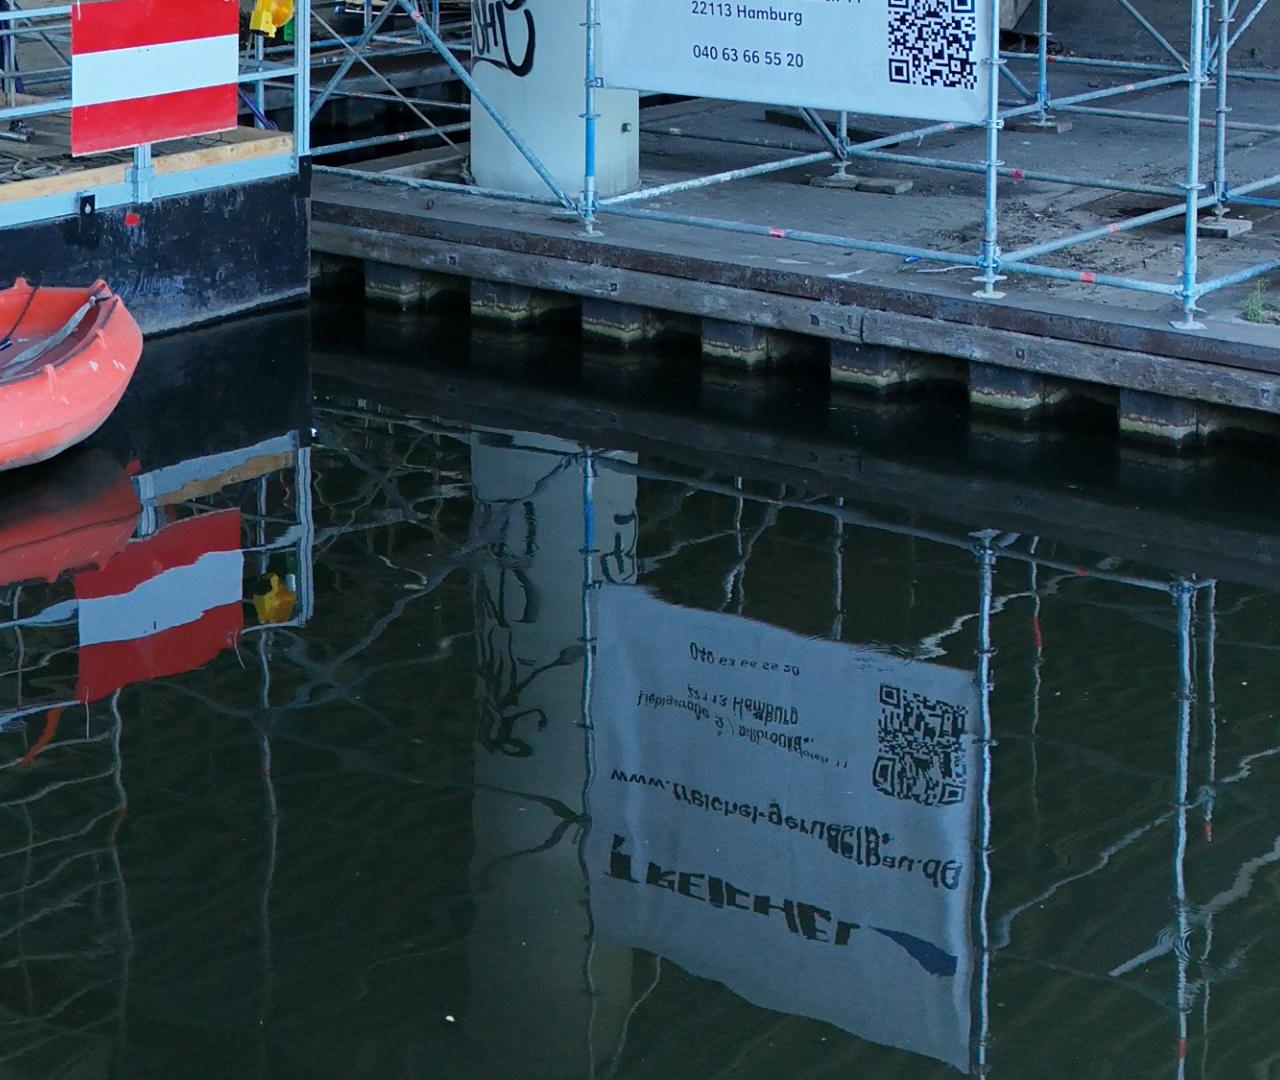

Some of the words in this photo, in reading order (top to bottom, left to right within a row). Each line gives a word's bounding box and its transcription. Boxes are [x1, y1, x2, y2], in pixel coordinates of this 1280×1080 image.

[691, 0, 732, 17] 22113
[736, 4, 803, 26] Hamburg
[692, 44, 718, 60] 040
[722, 47, 738, 62] 63
[743, 49, 760, 64] 66
[764, 51, 782, 66] 55
[786, 53, 804, 68] 20
